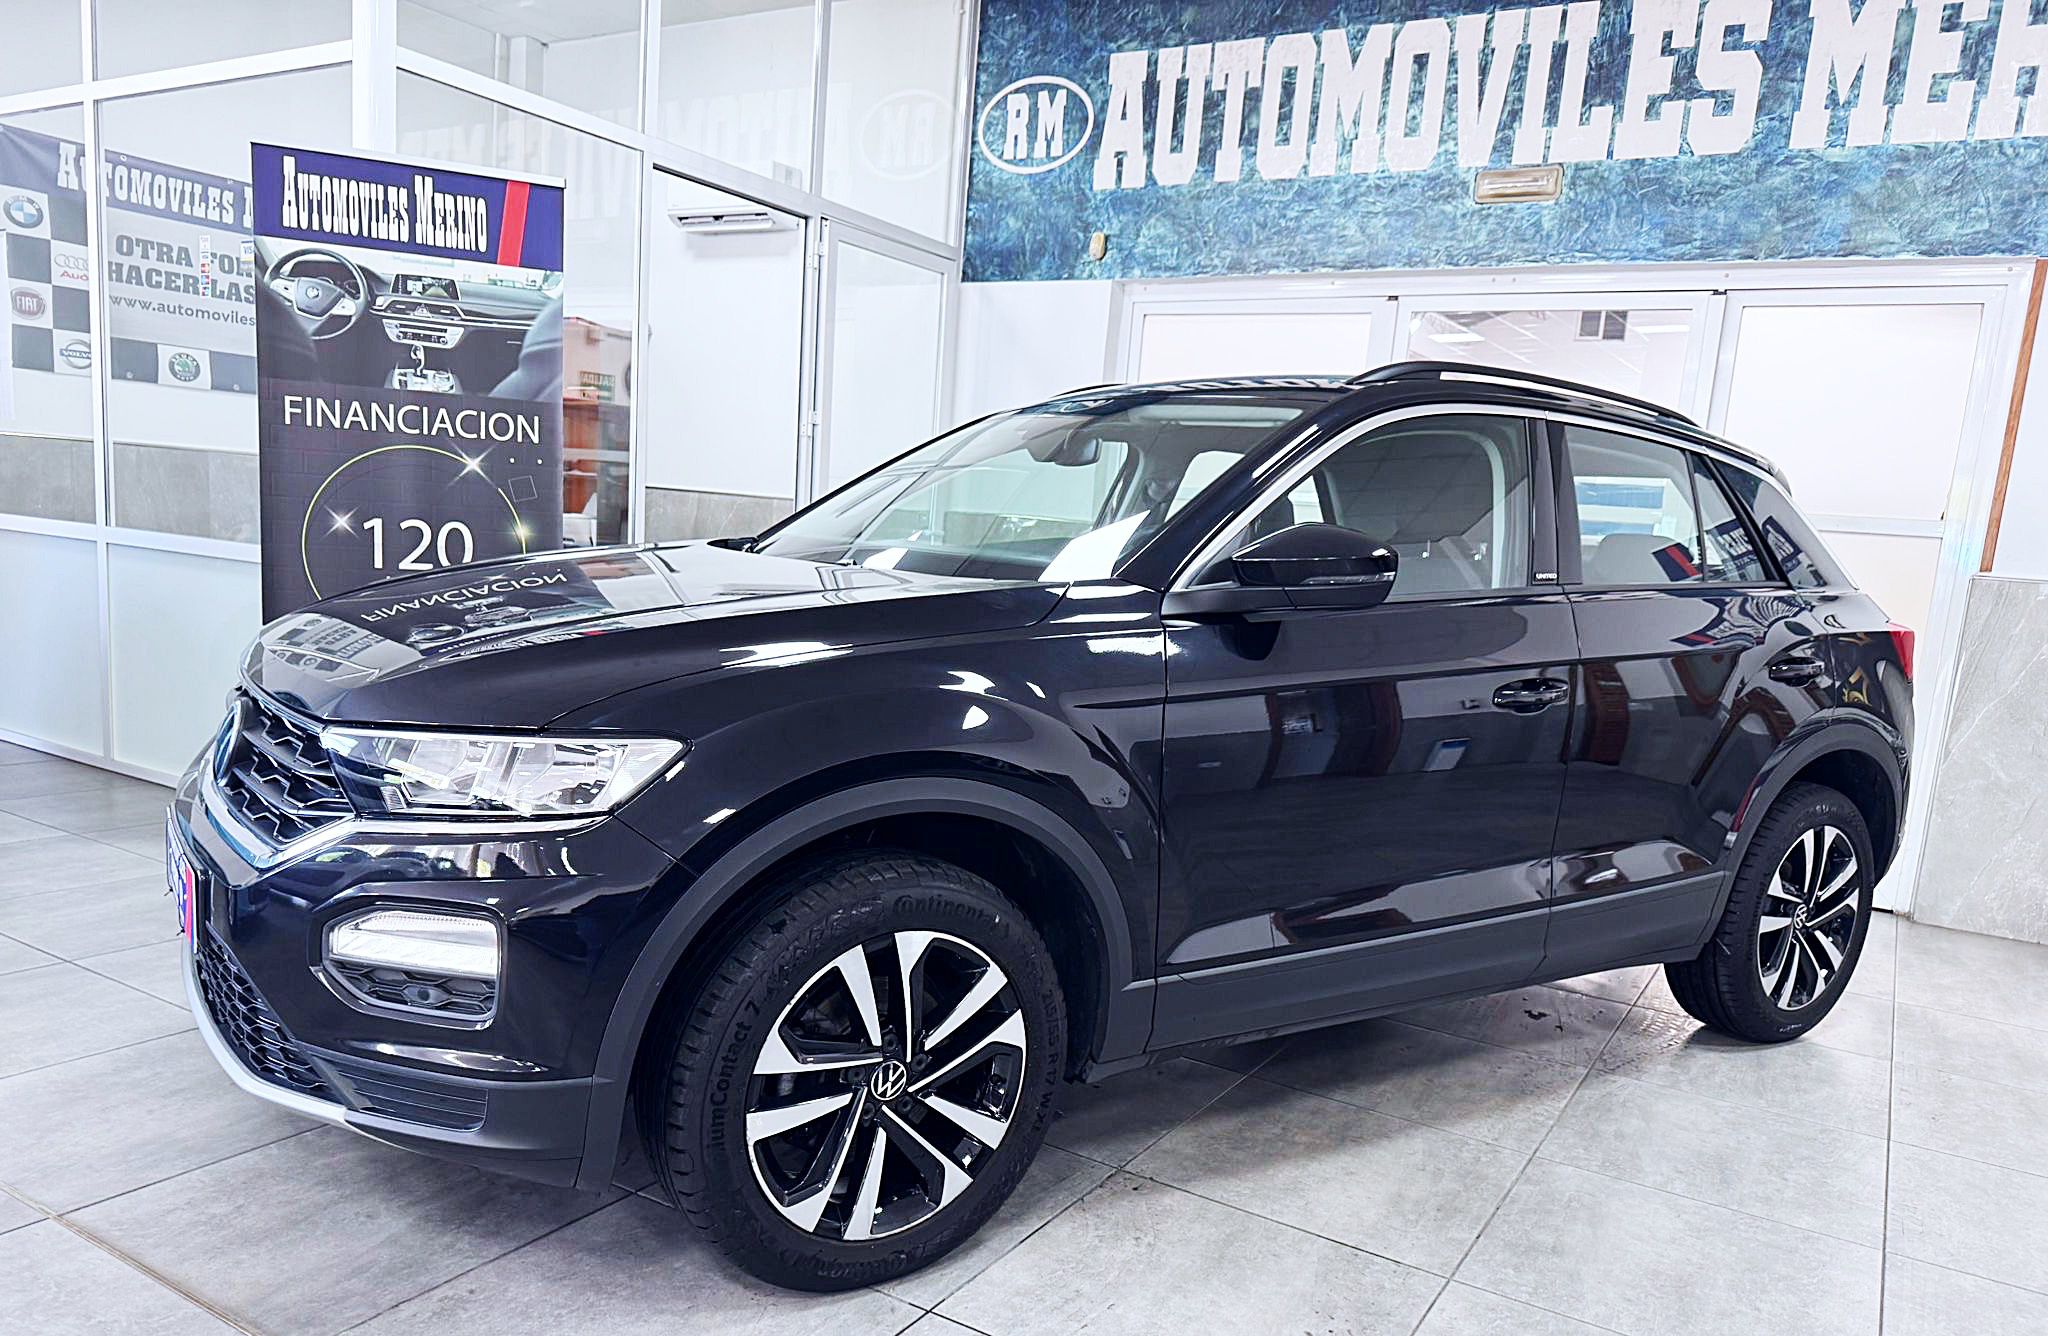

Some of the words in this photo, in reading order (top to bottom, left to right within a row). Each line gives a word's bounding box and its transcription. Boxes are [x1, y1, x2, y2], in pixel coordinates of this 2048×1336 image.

[1093, 0, 1770, 191] AUTOMOVILES
[1003, 88, 1067, 160] RM
[282, 155, 410, 243] AUTOMOVILES
[414, 174, 488, 252] MERINO
[60, 270, 89, 281] AUD
[115, 234, 194, 268] OTRA
[108, 260, 199, 296] HACER
[16, 295, 39, 312] FIAT
[284, 395, 541, 445] FINANCIACION
[363, 517, 475, 571] 120
